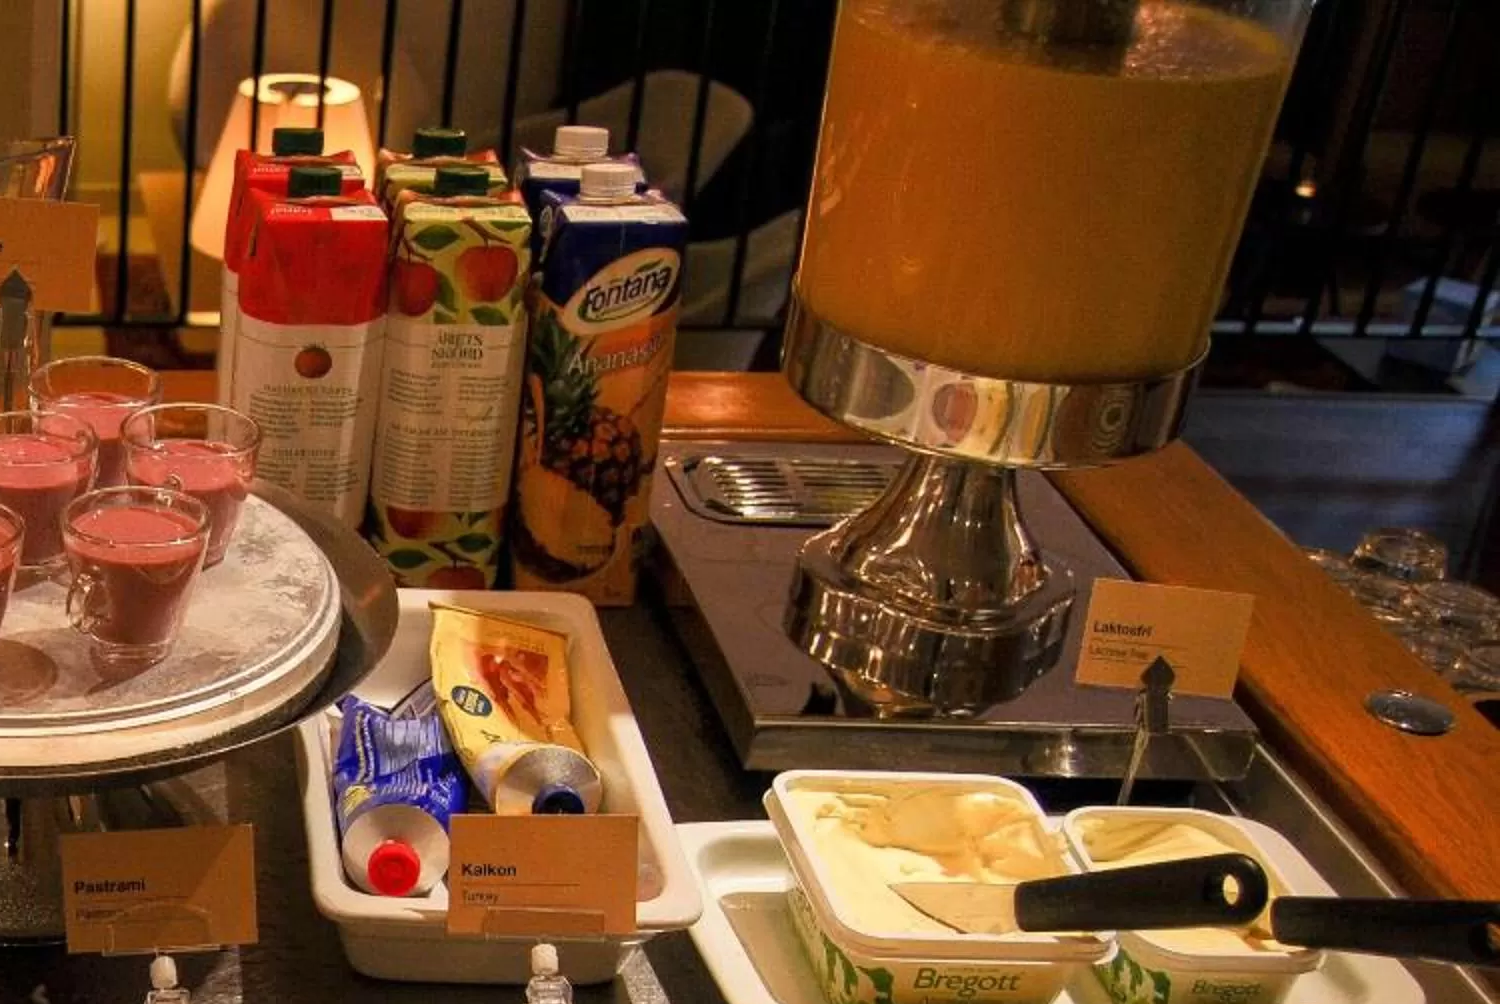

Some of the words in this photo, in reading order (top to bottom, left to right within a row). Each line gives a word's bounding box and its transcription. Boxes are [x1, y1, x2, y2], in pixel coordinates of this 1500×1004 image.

[585, 265, 673, 313] Fontana
[1093, 620, 1153, 638] Laktosfri
[461, 862, 518, 878] Kalkon
[74, 878, 146, 896] Pastrami
[913, 966, 1022, 998] Bregott
